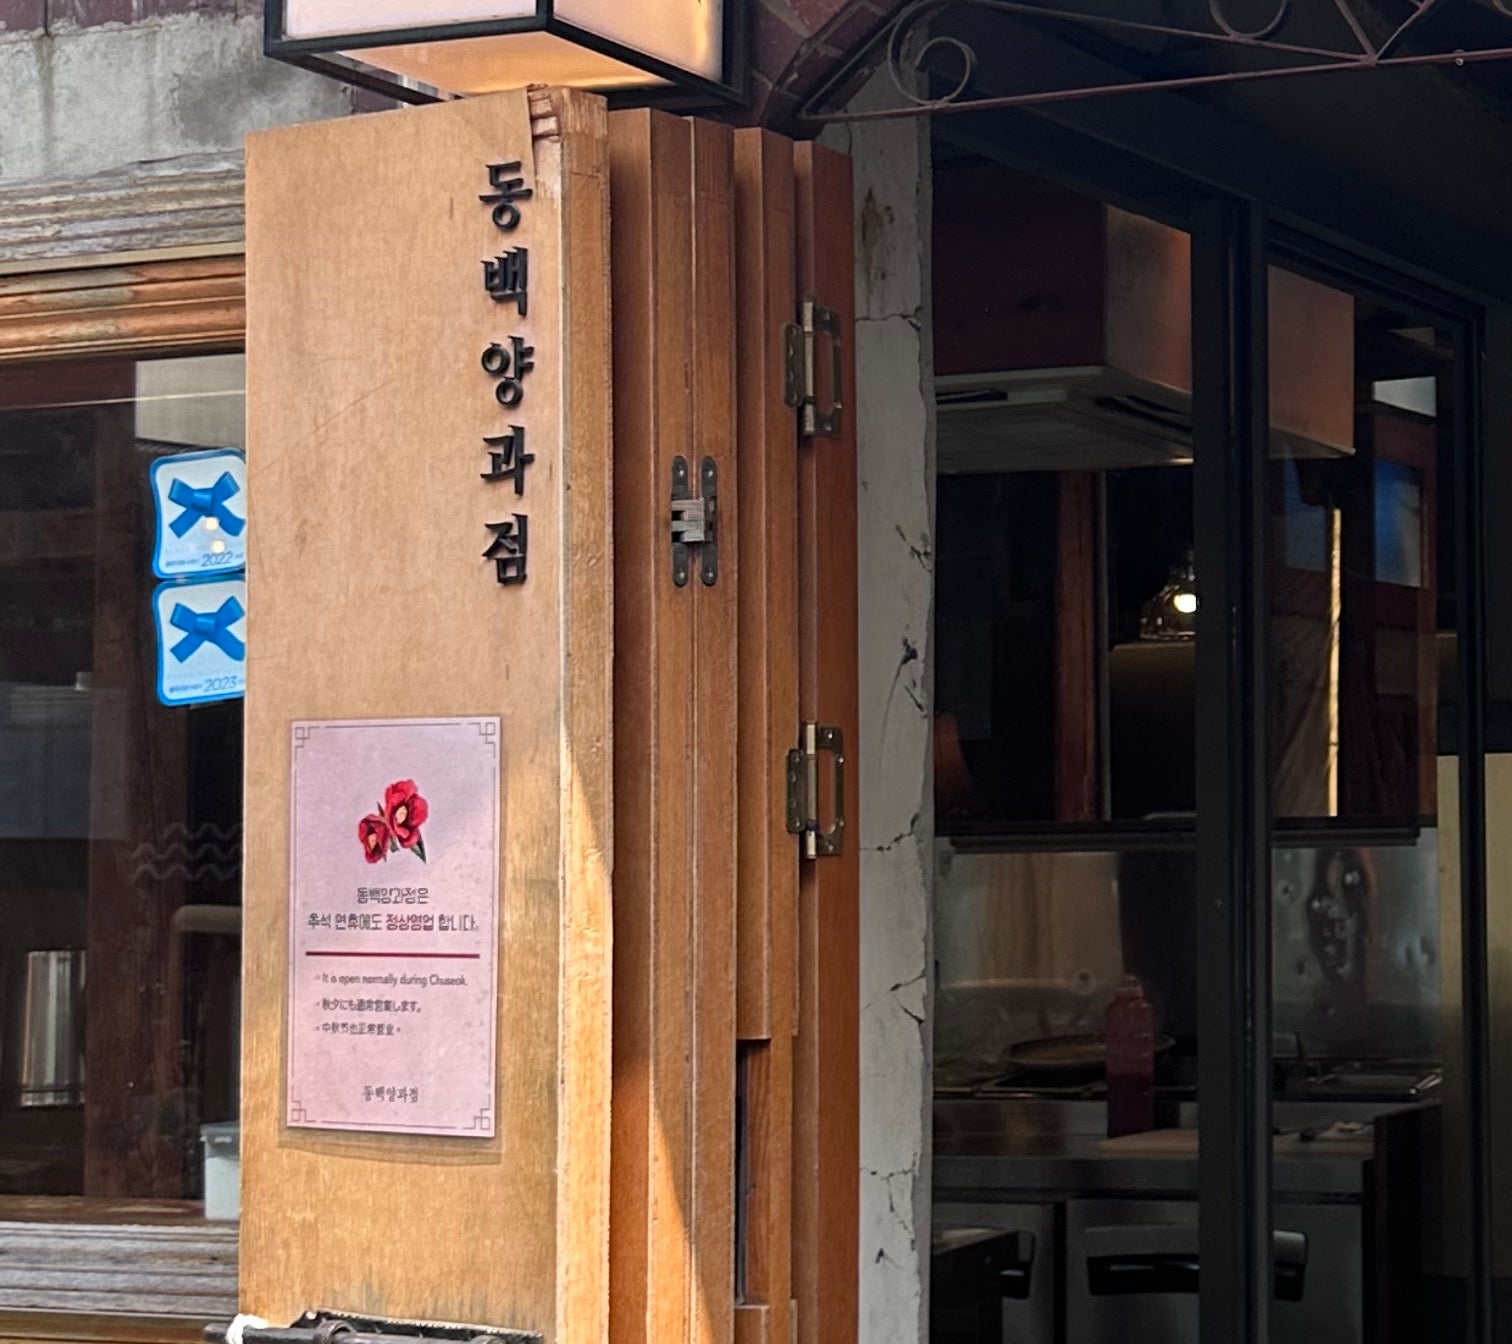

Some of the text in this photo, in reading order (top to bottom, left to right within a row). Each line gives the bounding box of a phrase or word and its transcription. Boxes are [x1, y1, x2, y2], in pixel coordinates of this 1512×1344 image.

[479, 160, 535, 588] 동백양과점
[201, 550, 234, 567] 2022
[204, 675, 238, 692] 2023
[308, 912, 332, 930] 추석
[386, 913, 434, 932] 정상영업
[338, 975, 361, 986] open
[400, 973, 428, 988] during
